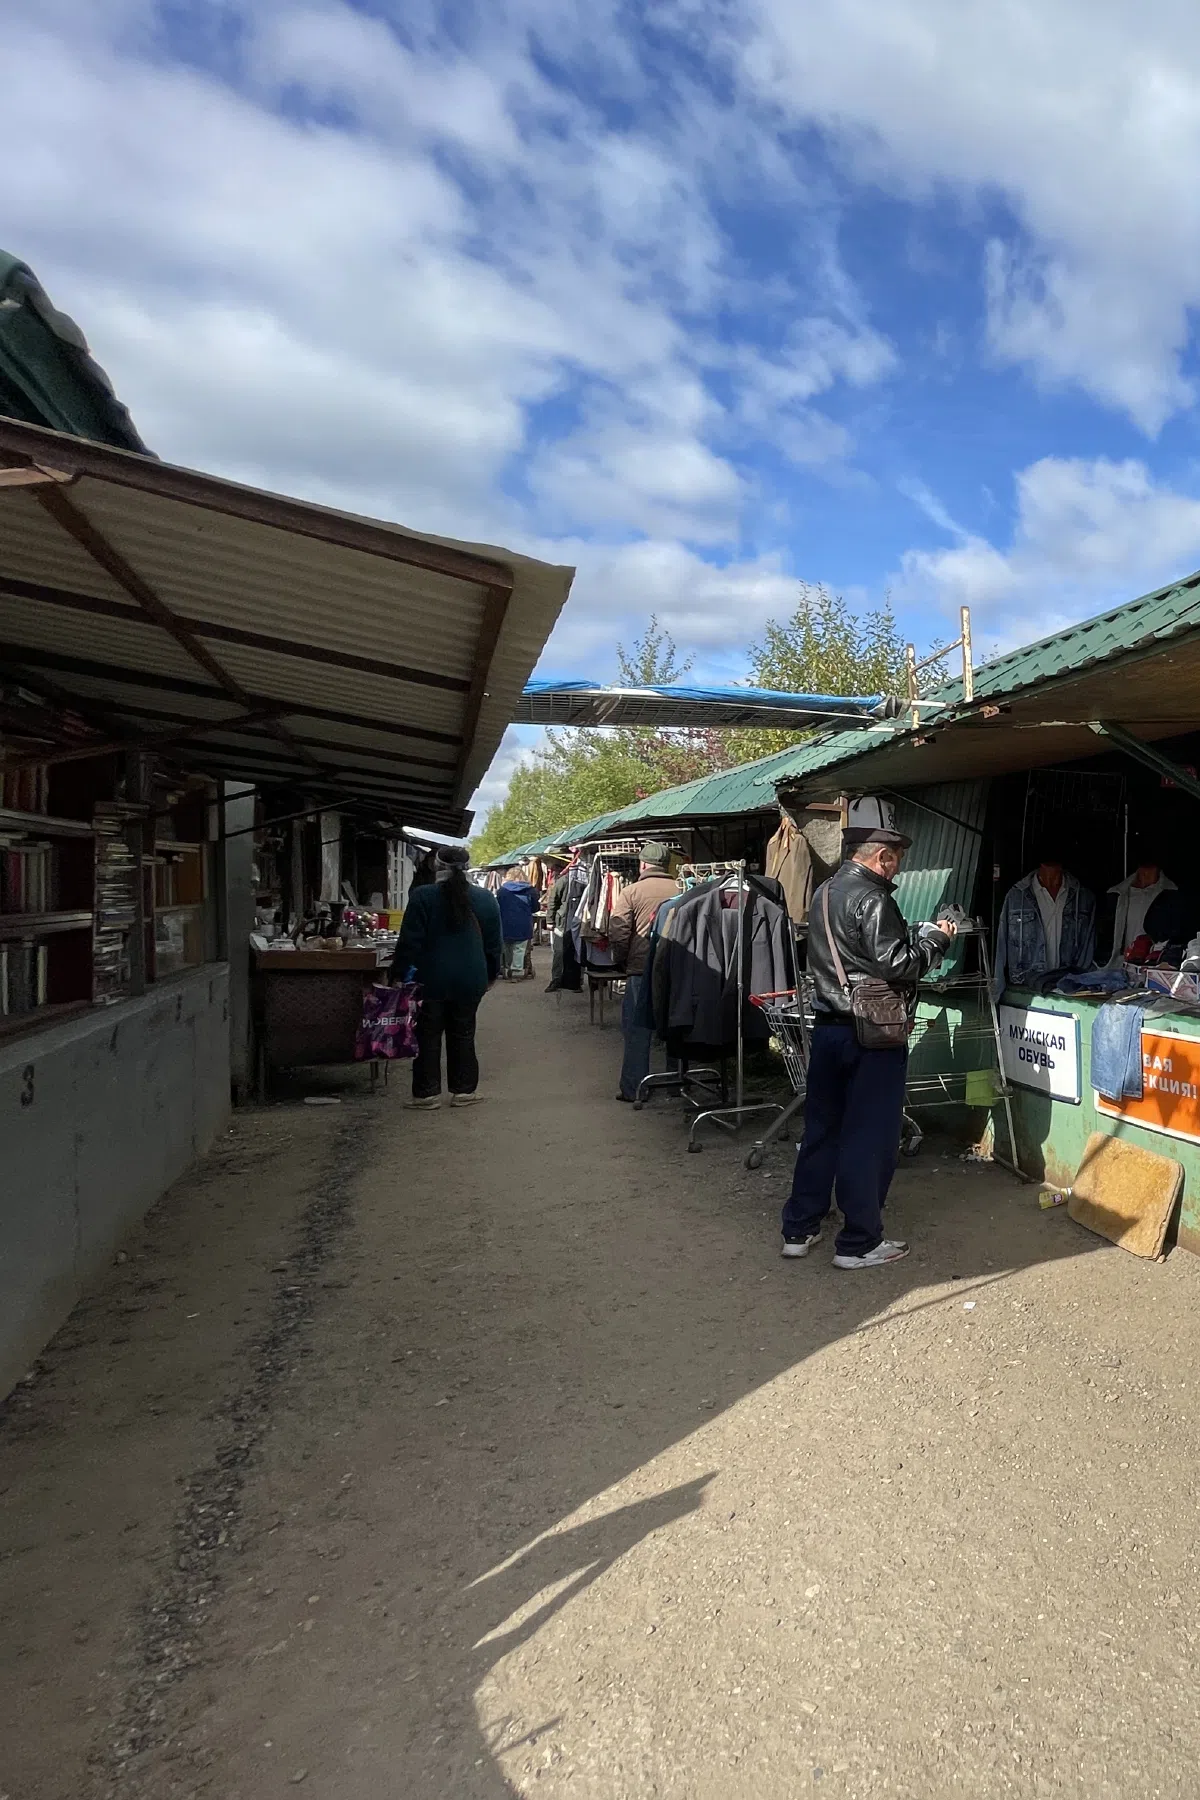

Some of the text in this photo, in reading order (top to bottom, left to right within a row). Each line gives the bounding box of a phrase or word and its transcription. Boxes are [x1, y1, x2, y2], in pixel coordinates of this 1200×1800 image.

[1009, 1024, 1066, 1051] МУЖСКАЯ
[1018, 1047, 1055, 1070] ОБУВЬ
[1143, 1053, 1173, 1073] ВАЯ
[1142, 1072, 1197, 1100] ЕКЦИЯ!
